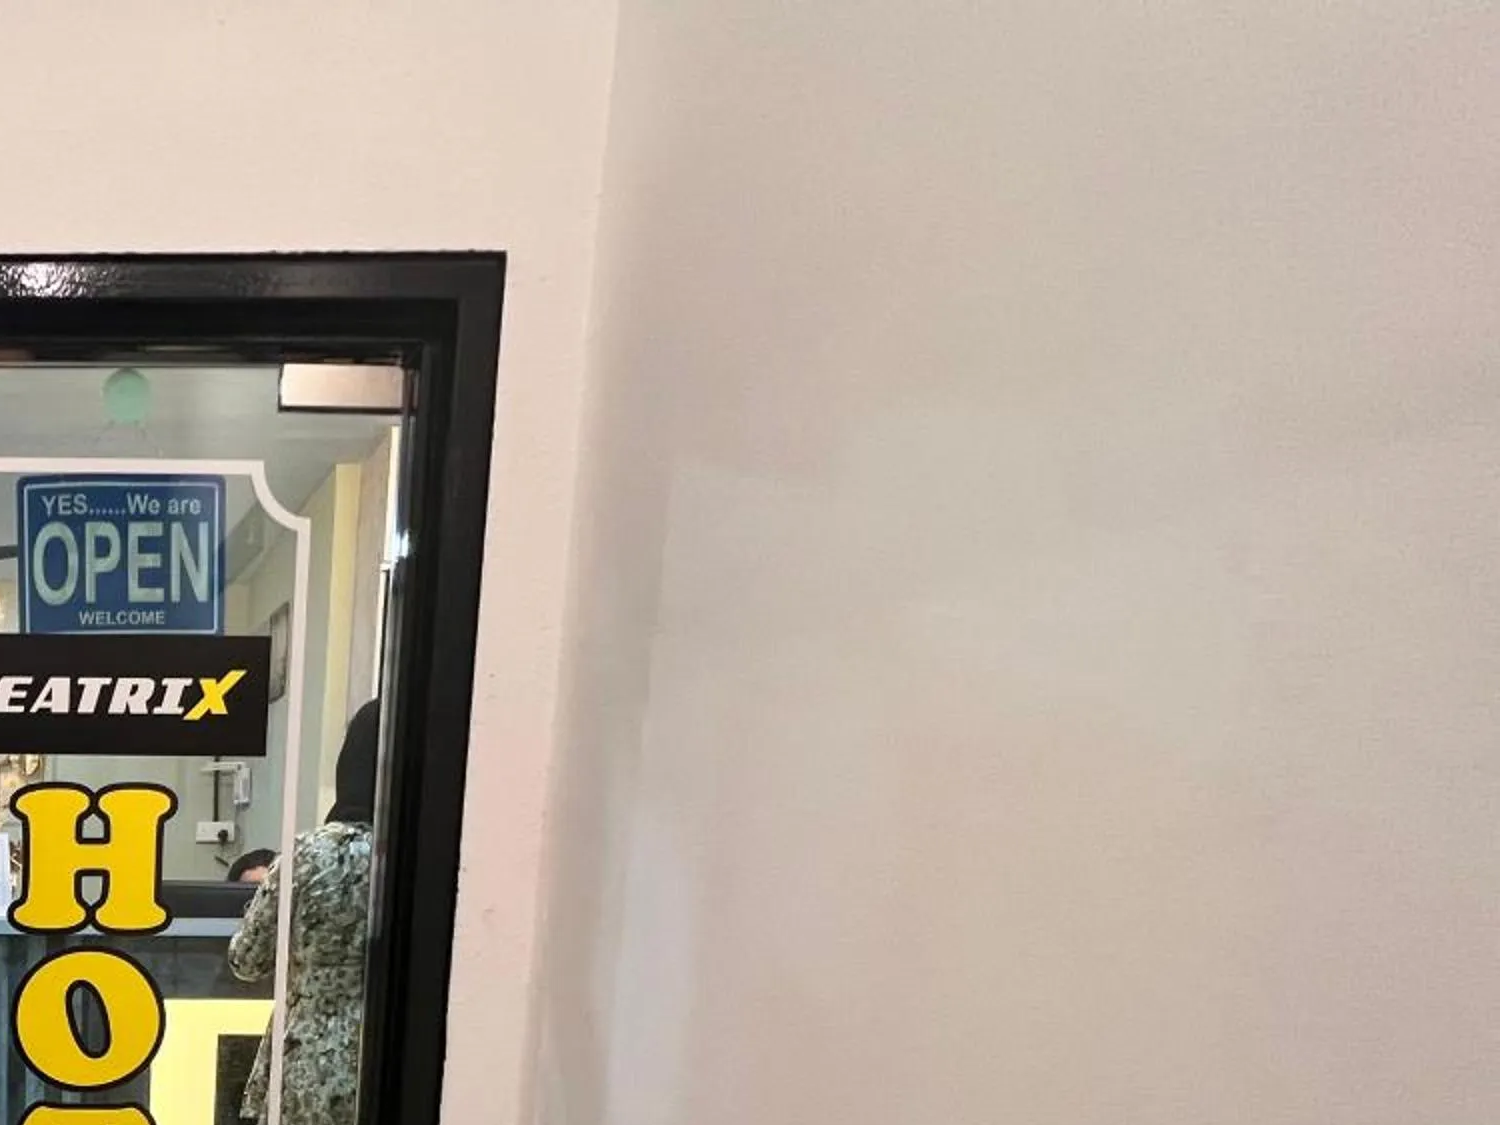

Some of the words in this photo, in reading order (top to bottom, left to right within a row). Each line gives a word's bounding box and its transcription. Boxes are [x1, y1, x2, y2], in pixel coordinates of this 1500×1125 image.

[167, 496, 202, 515] are
[33, 521, 210, 606] OPEN
[78, 611, 166, 626] WELCOME
